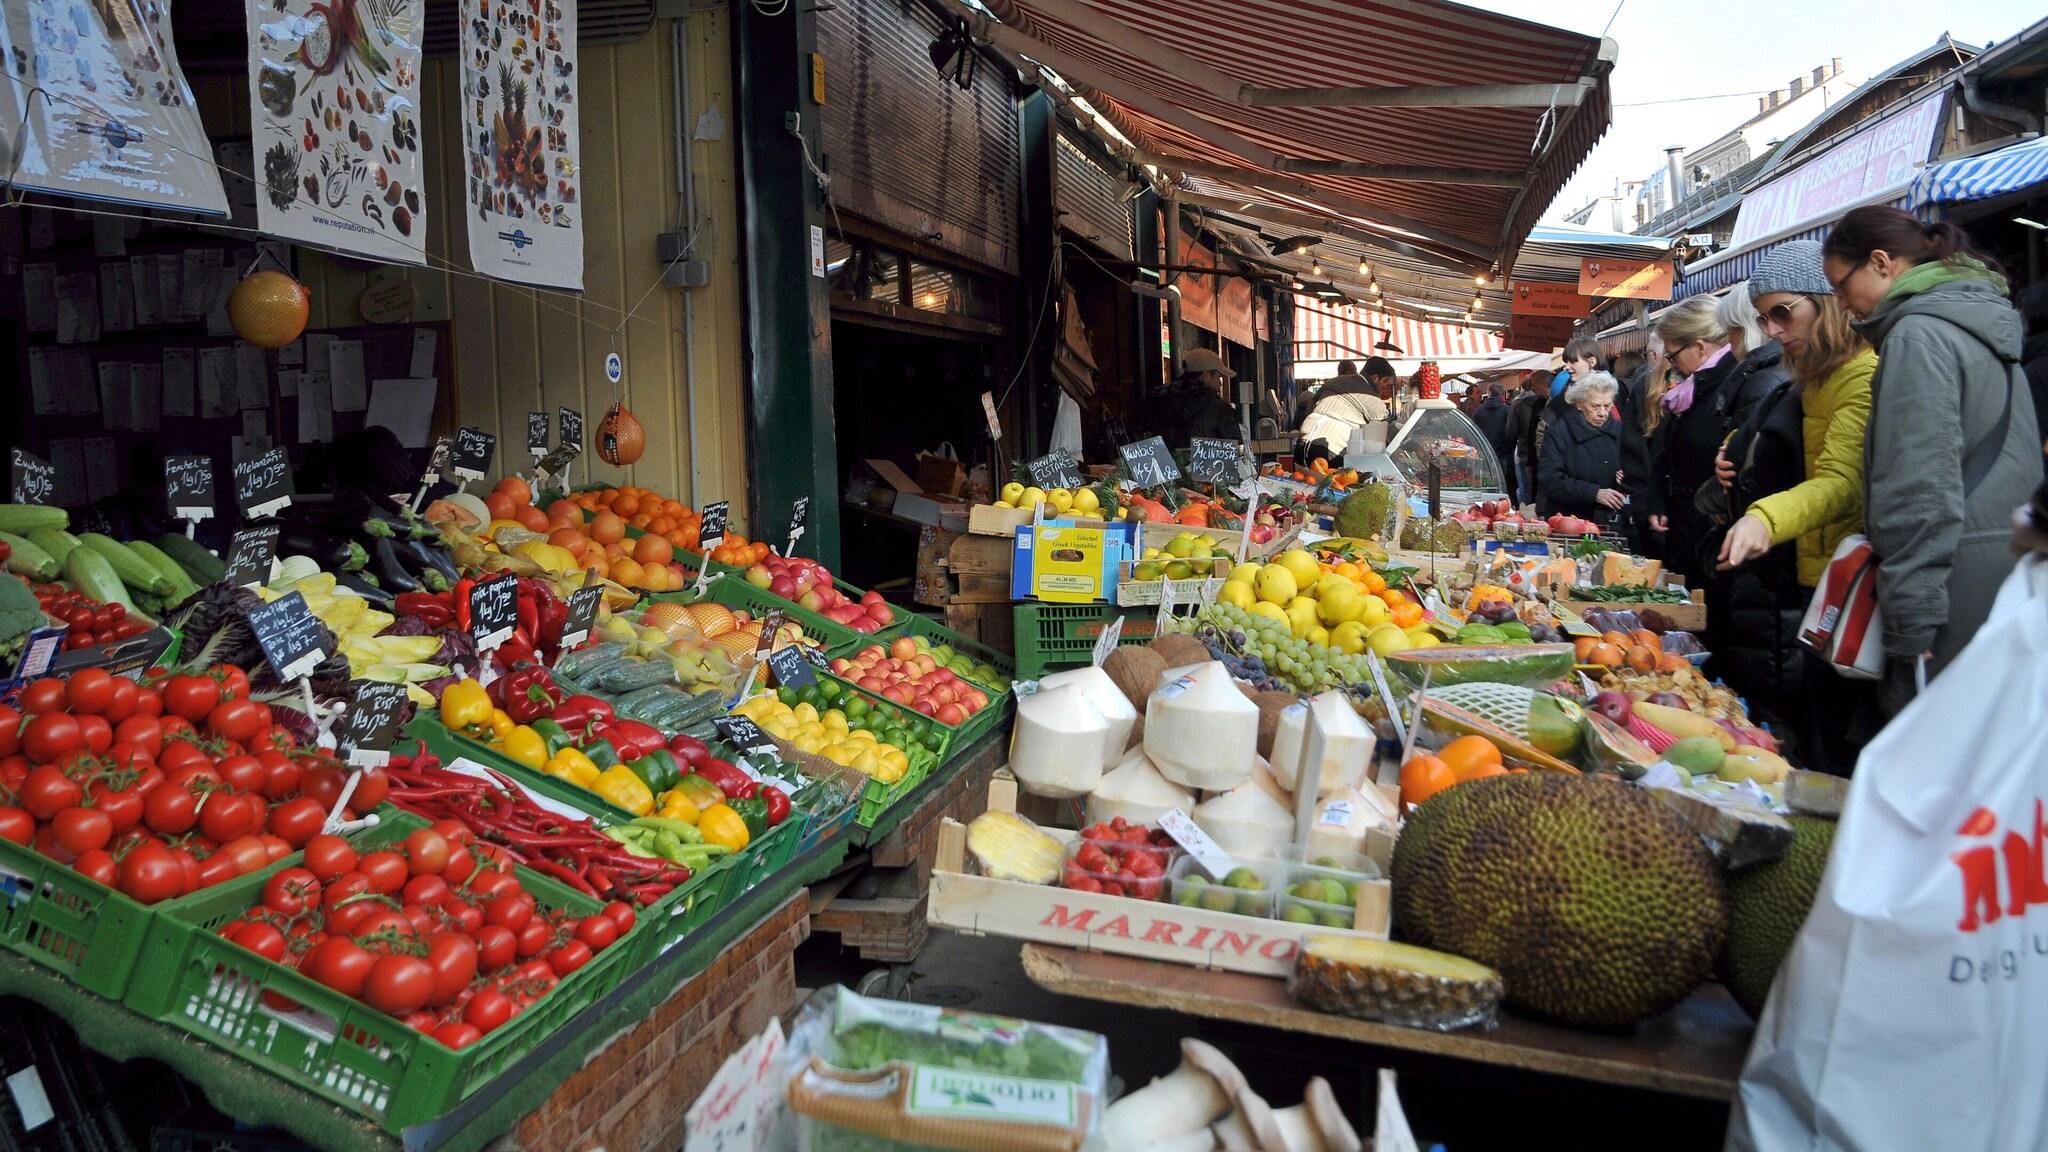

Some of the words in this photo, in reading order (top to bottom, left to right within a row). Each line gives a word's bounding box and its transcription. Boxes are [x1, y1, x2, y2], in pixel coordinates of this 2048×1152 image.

[312, 215, 375, 235] www.reputation.nl
[1627, 283, 1650, 291] Gasse
[1040, 903, 1299, 961] MARINO
